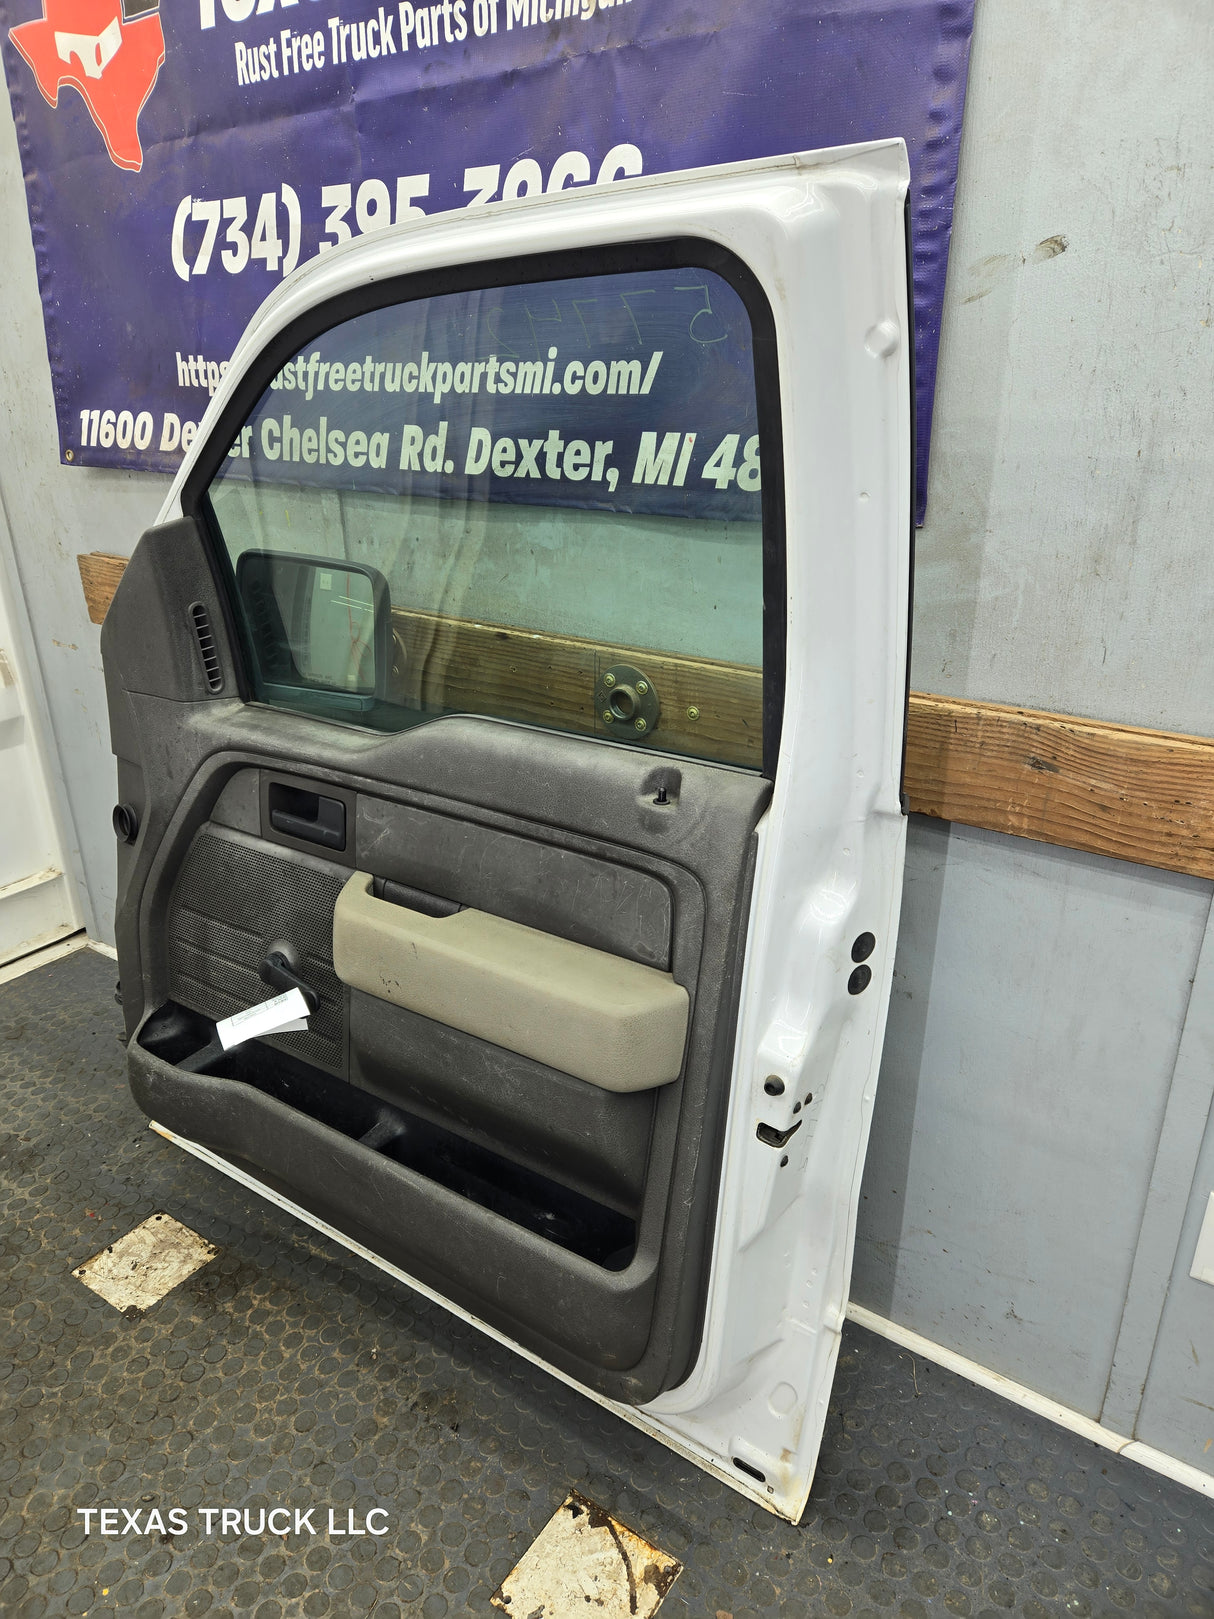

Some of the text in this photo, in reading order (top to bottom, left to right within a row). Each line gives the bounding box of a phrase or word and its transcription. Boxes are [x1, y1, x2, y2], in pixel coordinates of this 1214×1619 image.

[234, 41, 279, 86] Rust
[280, 29, 326, 76] Free
[328, 6, 397, 65] Truck
[399, 0, 468, 52] Parts
[171, 183, 302, 282] (734)
[79, 409, 153, 450] 11600
[261, 414, 390, 469] Chelsea
[399, 421, 455, 474] Rd.
[464, 426, 620, 493] Dexter,
[632, 431, 697, 487] MI
